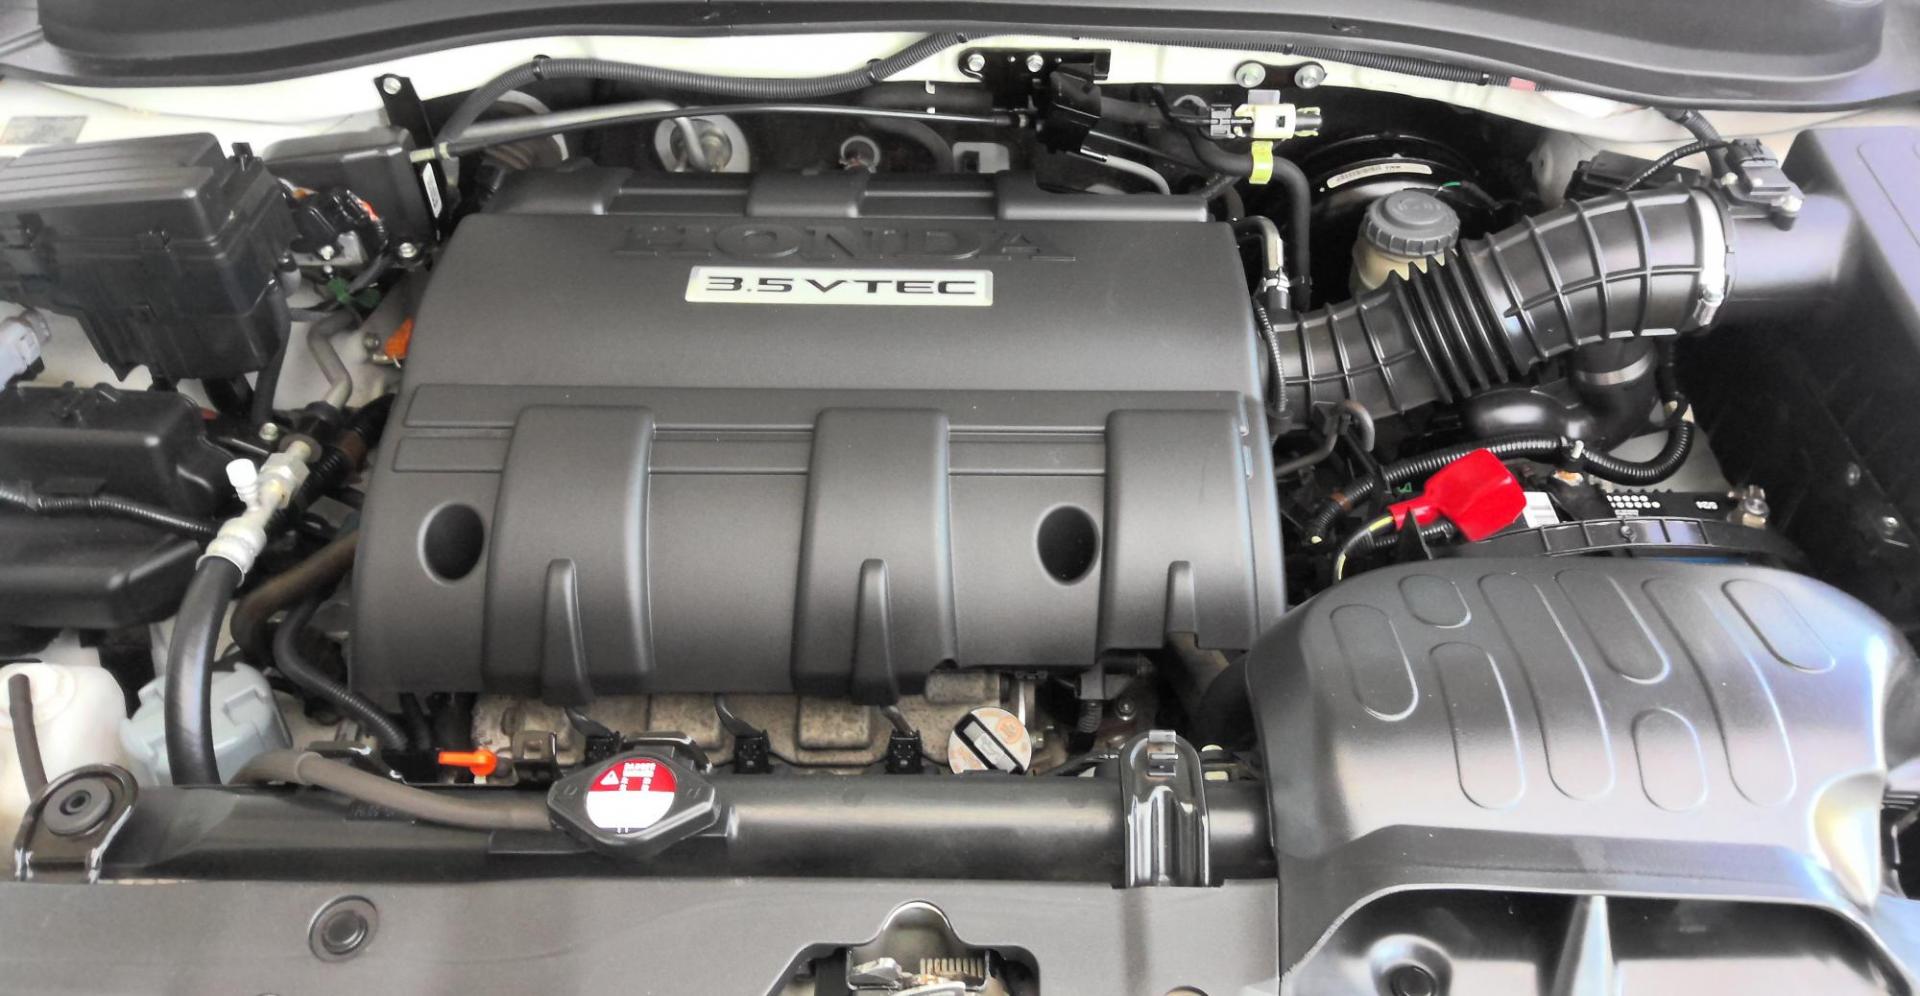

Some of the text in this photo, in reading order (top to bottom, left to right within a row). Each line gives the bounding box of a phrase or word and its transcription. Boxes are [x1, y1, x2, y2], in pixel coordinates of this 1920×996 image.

[612, 223, 1077, 261] HONDA
[706, 275, 977, 295] 3.5 VTEC
